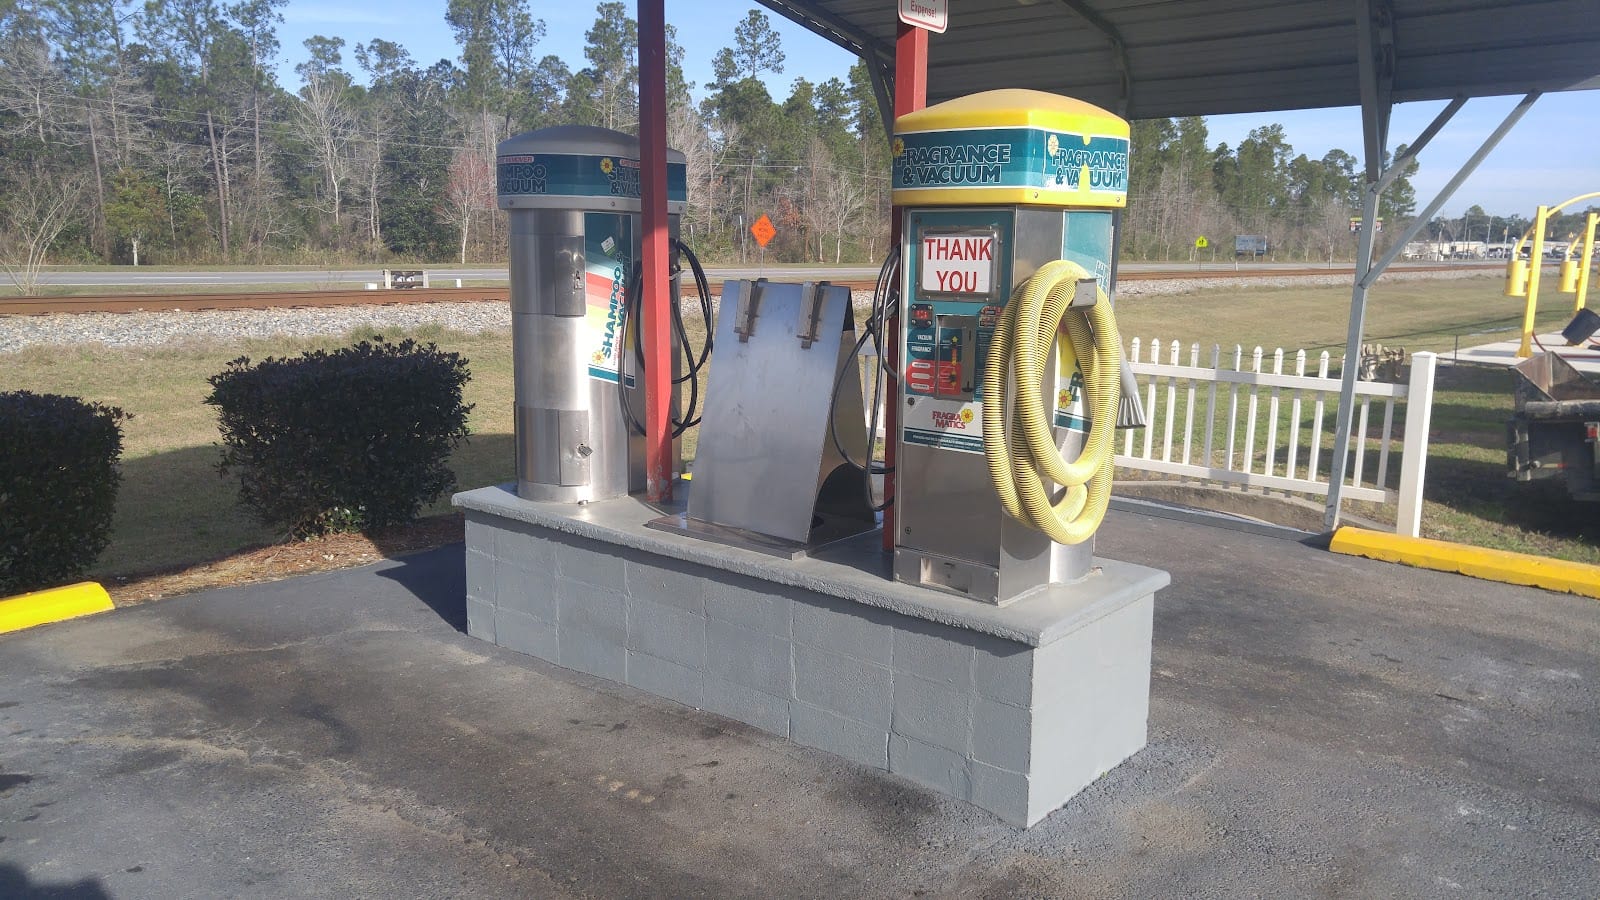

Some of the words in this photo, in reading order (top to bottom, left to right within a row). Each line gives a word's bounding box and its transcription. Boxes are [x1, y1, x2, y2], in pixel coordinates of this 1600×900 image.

[911, 1, 937, 18] Expense!
[896, 144, 1011, 167] FRAGRANCE
[1052, 148, 1126, 171] FRAGRANCE
[902, 166, 915, 185] &
[917, 164, 1001, 184] VACUUM
[1056, 168, 1064, 185] &
[1066, 169, 1122, 188] VAUUM
[925, 238, 992, 261] THANK
[936, 270, 977, 293] YOU
[601, 266, 621, 359] SHAMPOO
[932, 410, 962, 422] FRAGRA
[935, 418, 966, 430] MATICS
